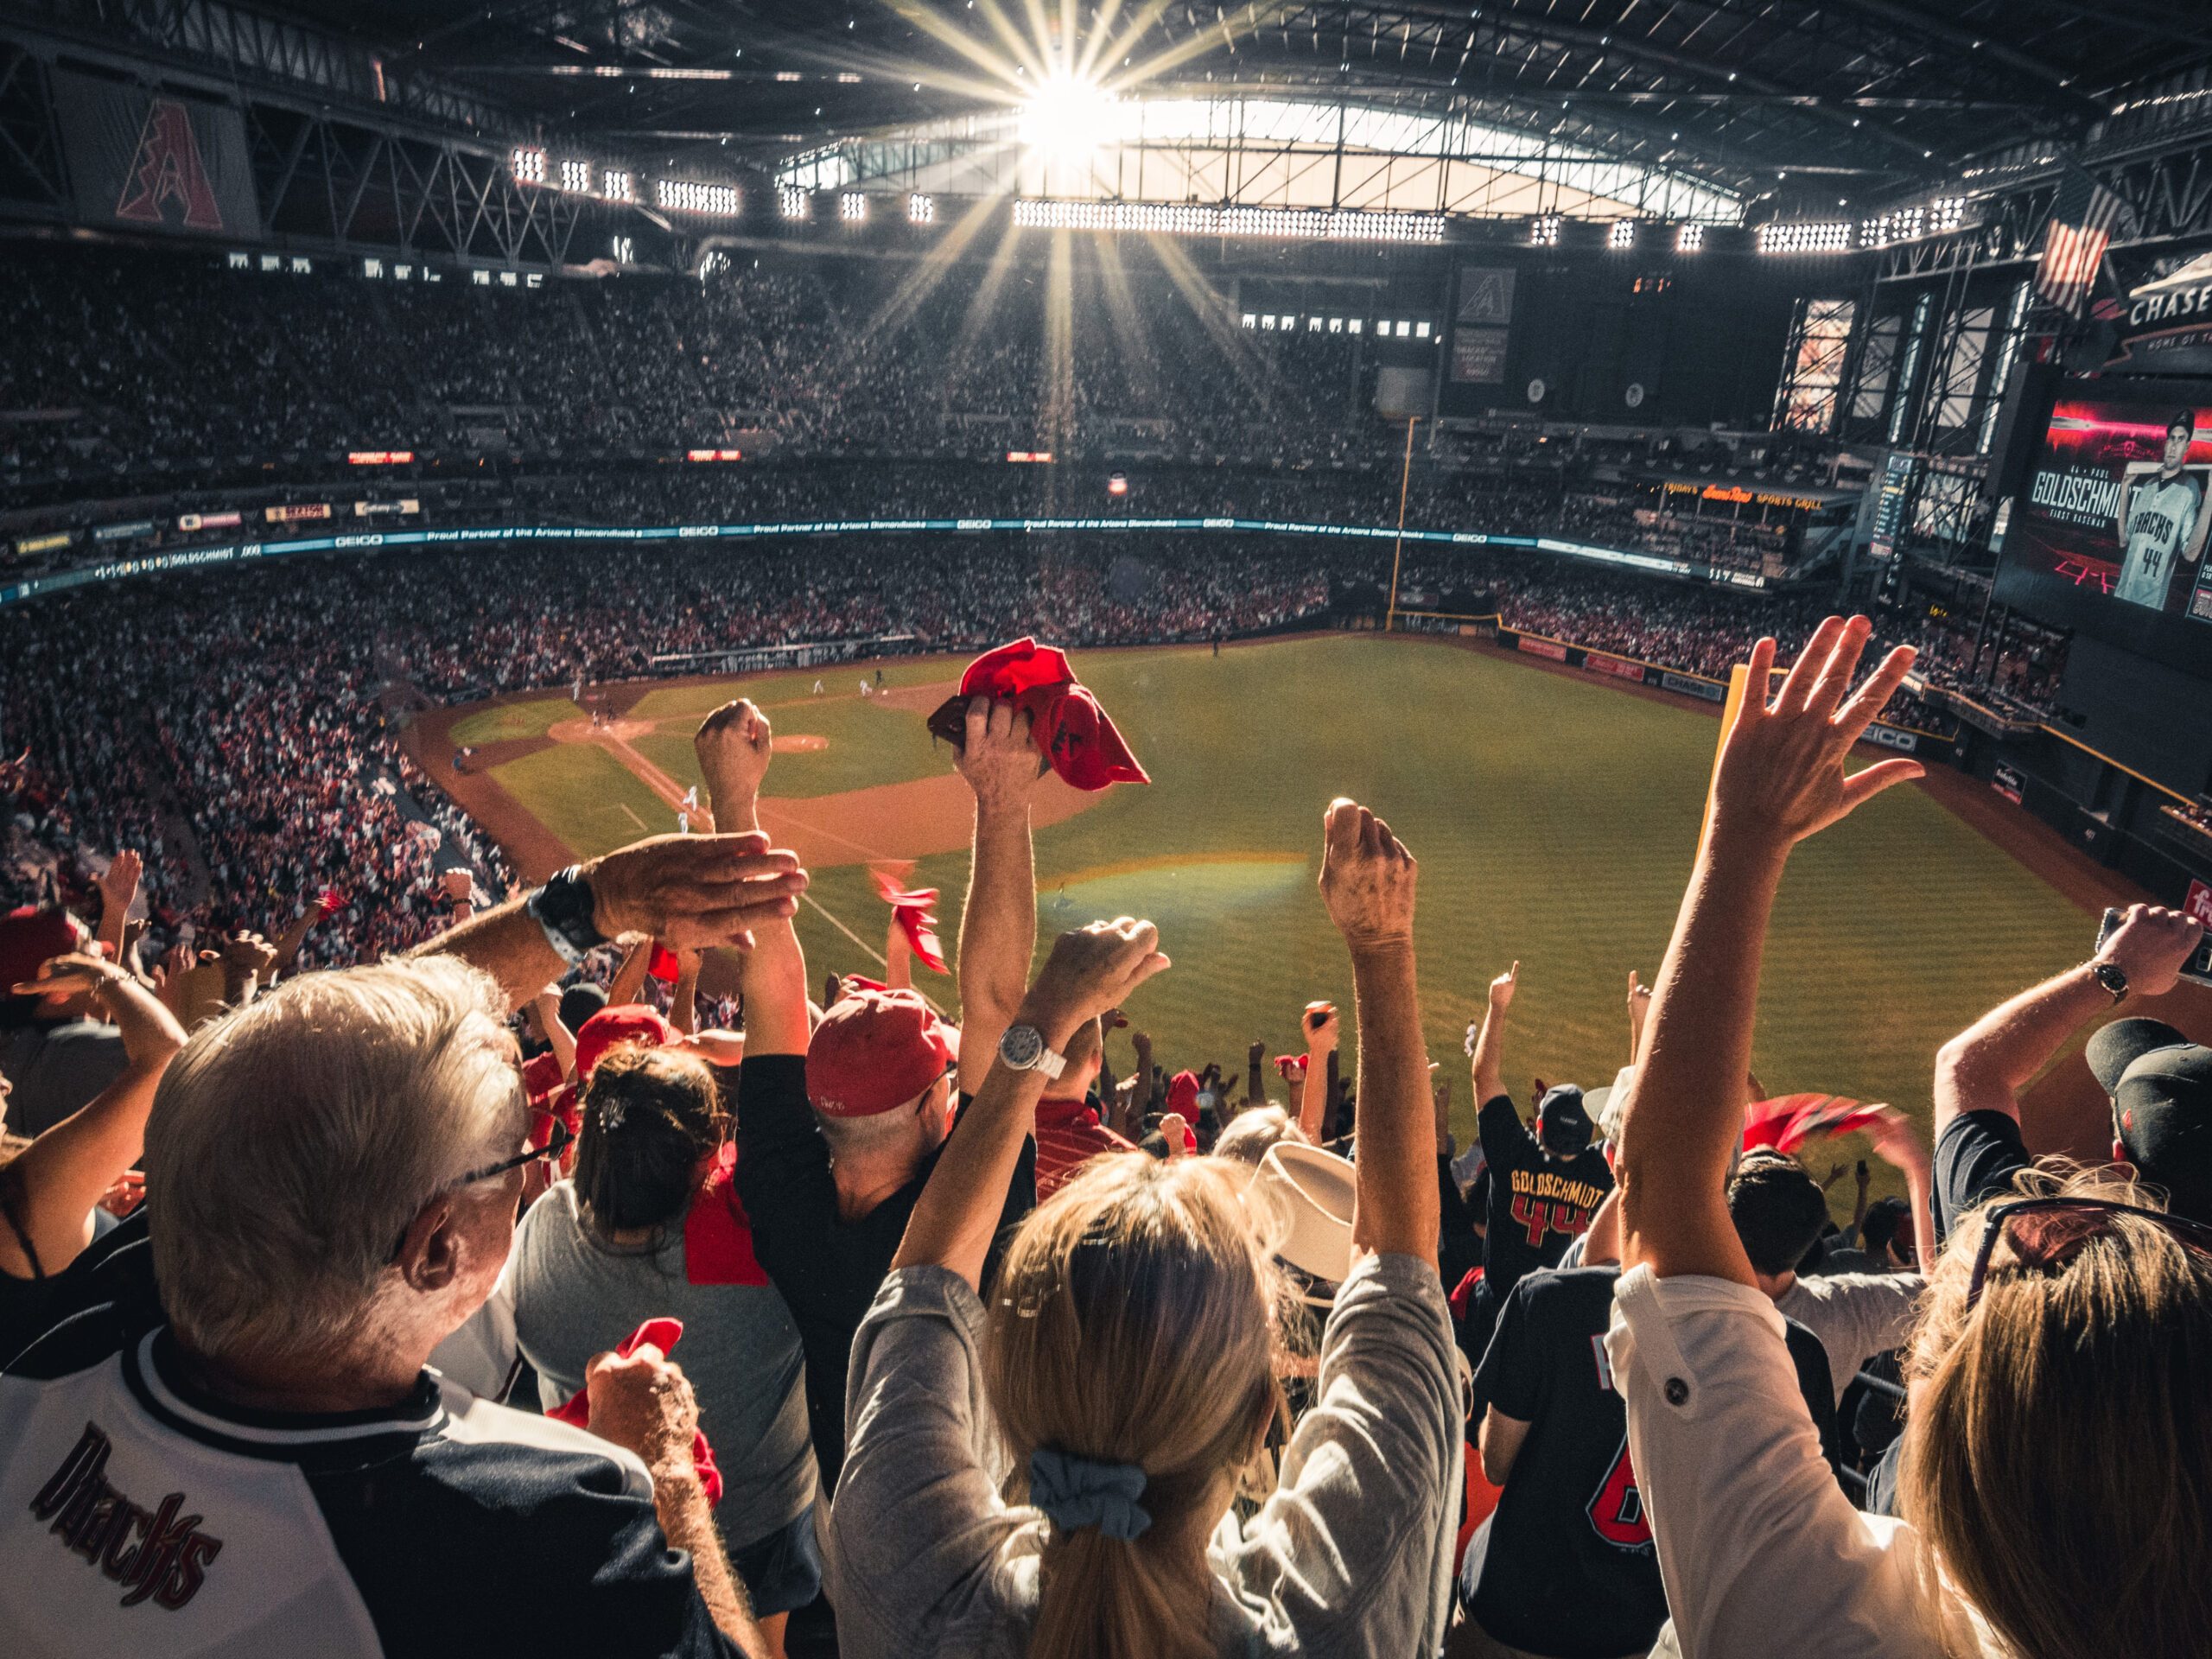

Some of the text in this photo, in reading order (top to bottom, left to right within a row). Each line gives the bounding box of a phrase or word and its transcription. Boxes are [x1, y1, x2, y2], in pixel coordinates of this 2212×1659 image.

[2130, 284, 2212, 327] CHASE
[2091, 467, 2110, 479] PAUL
[1663, 482, 1699, 495] FRIDAYS
[1757, 493, 1792, 507] SPORTS
[1795, 497, 1823, 511] GRILL
[2031, 471, 2143, 518] GOLDSCHMIT
[957, 519, 992, 530] GEICO
[1202, 518, 1235, 528] GEICO
[2050, 508, 2107, 529] FIRST BASEMAN
[428, 527, 643, 541] Proud Partner of the Arizona Diamondbacks
[678, 525, 719, 537] GEICO
[753, 524, 779, 534] Proud
[781, 524, 811, 533] Partner
[840, 522, 869, 531] Arizona
[870, 521, 926, 530] Diamondbacks
[1265, 522, 1287, 531] Proud
[1288, 523, 1318, 532] Partner
[1342, 525, 1370, 536] Arizona
[335, 534, 384, 548] GEICO
[1452, 532, 1488, 543] GEICO
[172, 547, 233, 566] GOLDSCHMIDT
[2143, 548, 2162, 577] 44
[1511, 1169, 1604, 1208] GOLDSCHMIDT
[1510, 1192, 1593, 1249] 44
